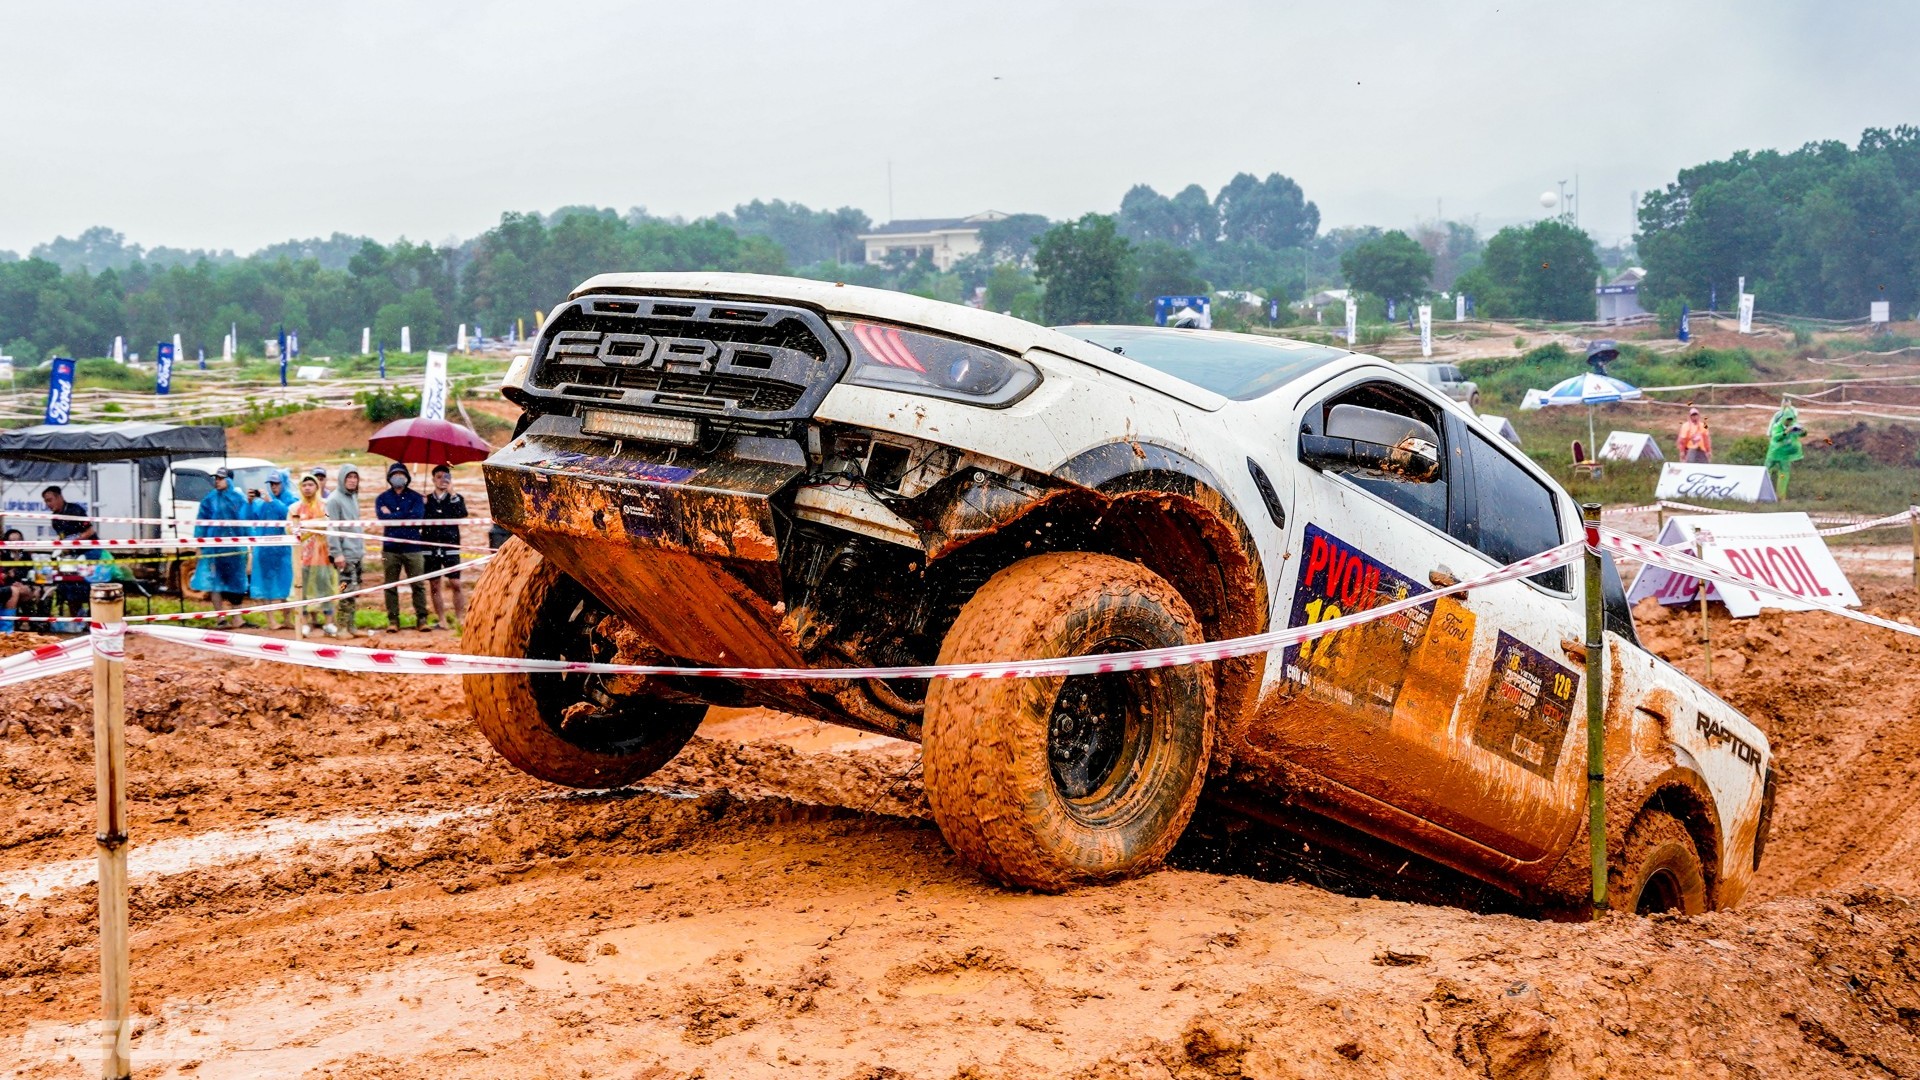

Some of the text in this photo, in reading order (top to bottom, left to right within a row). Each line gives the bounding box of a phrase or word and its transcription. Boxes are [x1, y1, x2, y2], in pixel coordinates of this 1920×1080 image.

[546, 331, 775, 376] FORD
[49, 378, 72, 424] Ford
[1677, 472, 1740, 497] Ford
[1723, 546, 1832, 601] PVOIL
[1553, 672, 1572, 700] 129
[1696, 711, 1762, 777] RAPTOR
